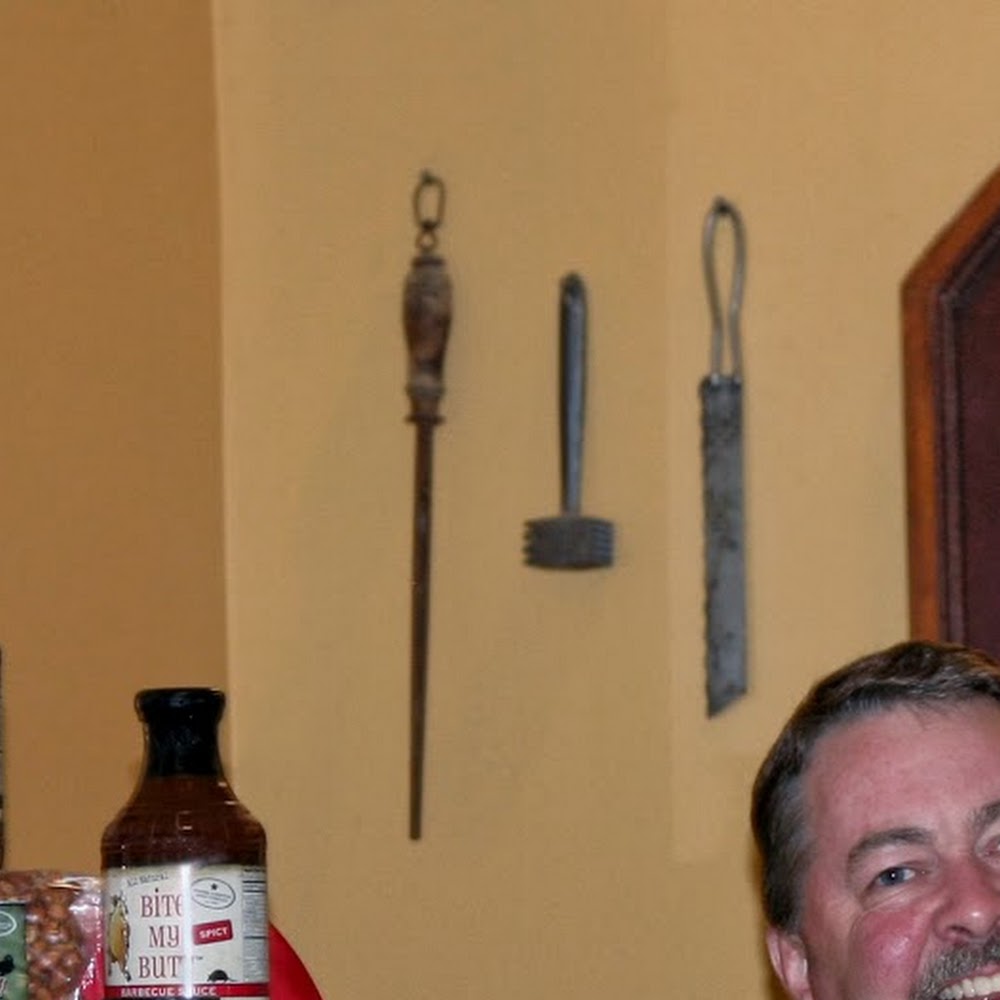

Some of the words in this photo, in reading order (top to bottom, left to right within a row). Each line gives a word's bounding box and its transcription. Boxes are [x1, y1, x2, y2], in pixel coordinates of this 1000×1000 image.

[198, 926, 229, 940] SPICY
[138, 955, 195, 979] BUT
[177, 986, 218, 997] SUCE
